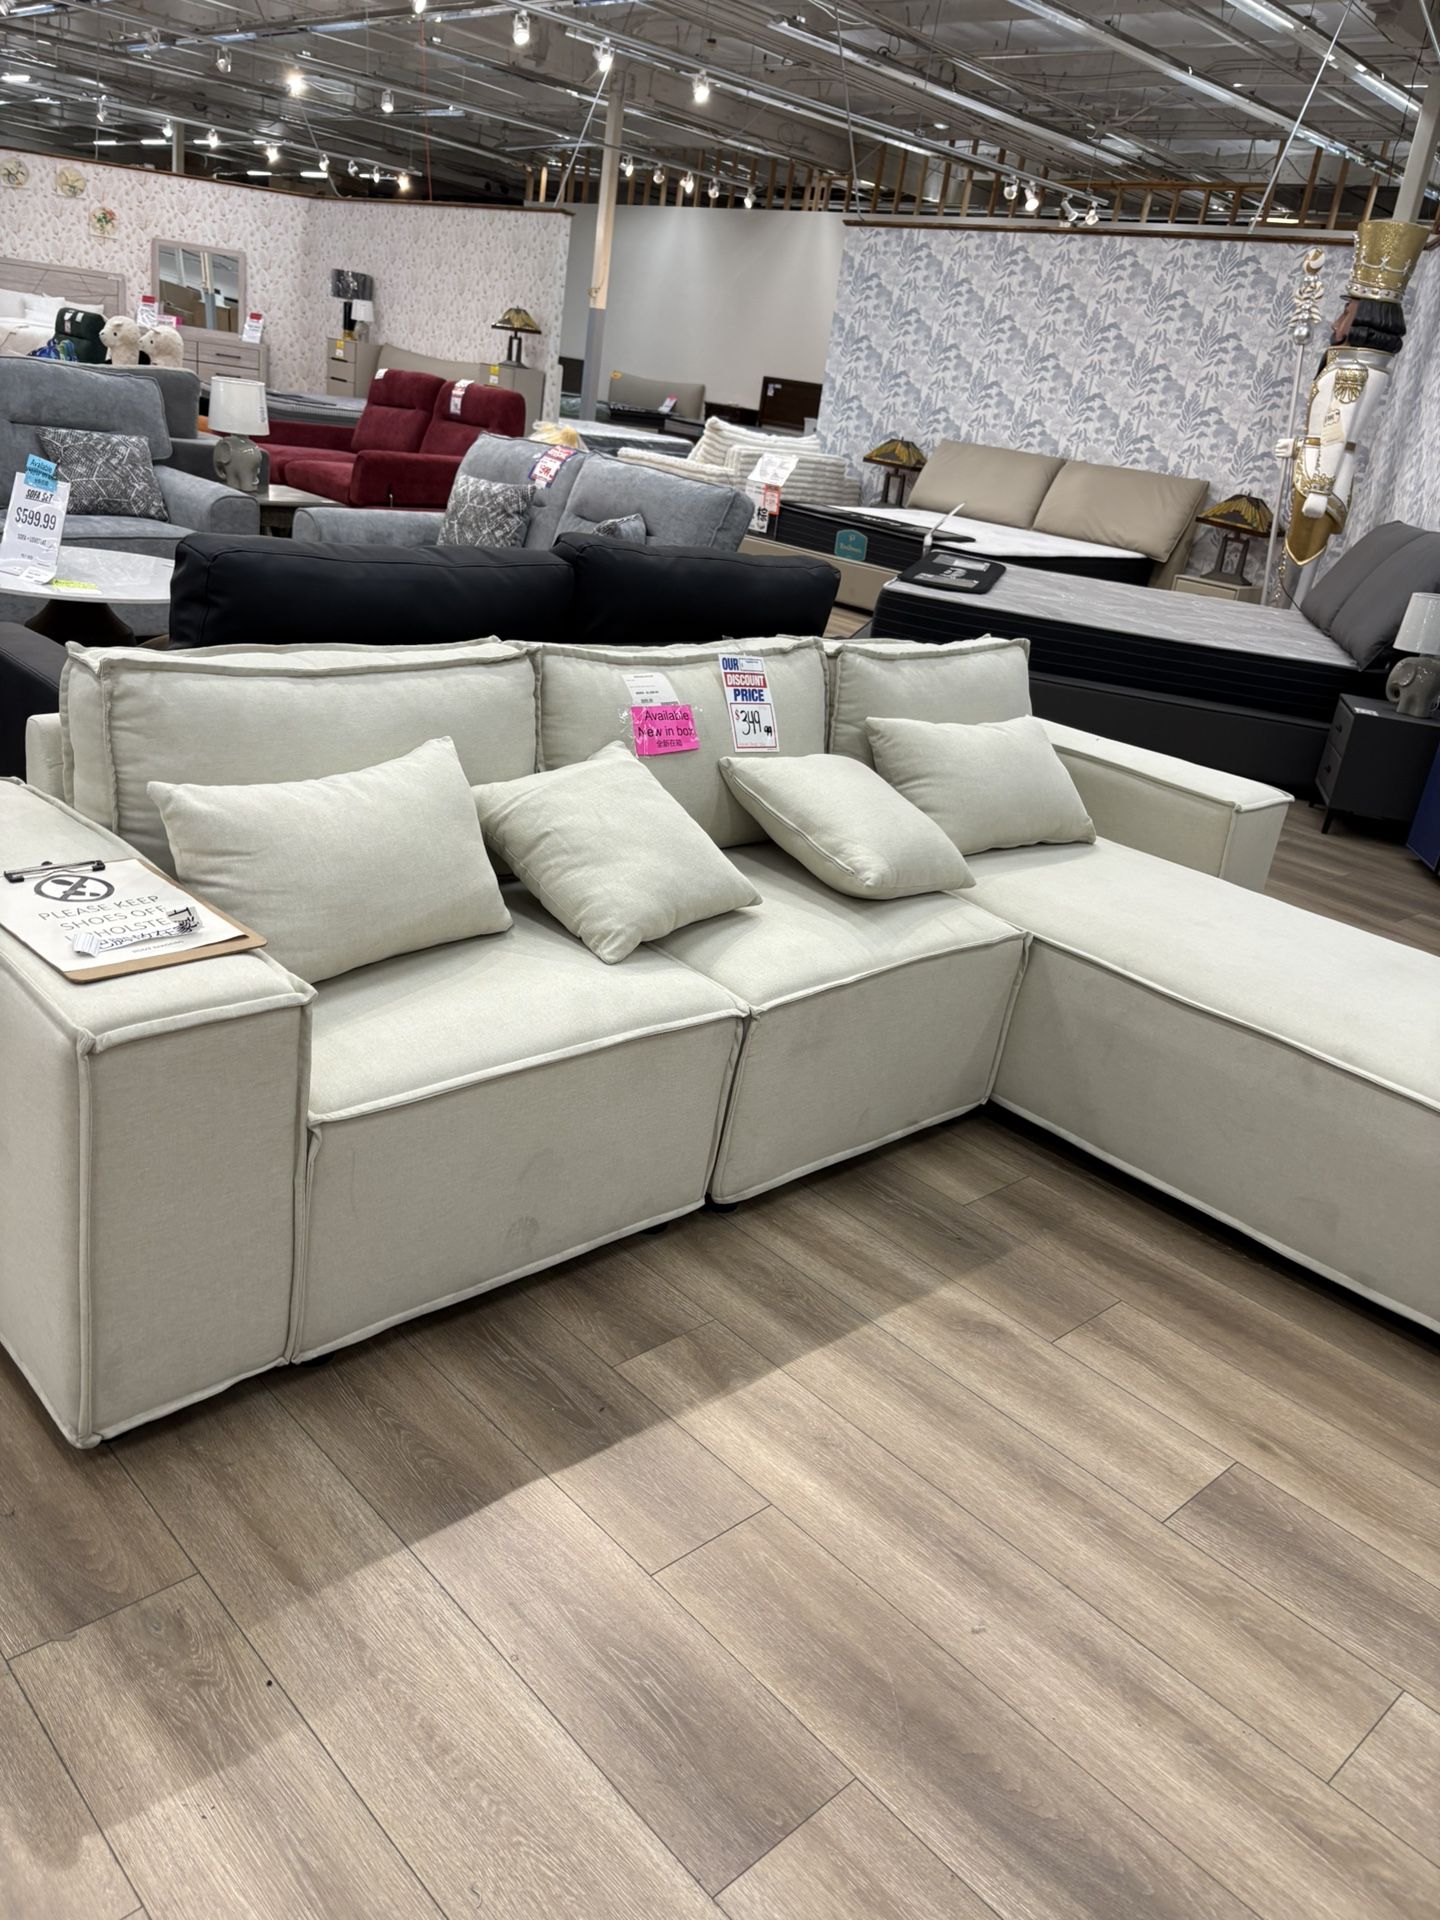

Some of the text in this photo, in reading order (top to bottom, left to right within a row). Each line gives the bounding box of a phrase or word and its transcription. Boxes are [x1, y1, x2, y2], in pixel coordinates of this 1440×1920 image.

[25, 489, 41, 500] SOFA
[15, 506, 57, 531] $599.99
[721, 657, 740, 671] OUR
[726, 673, 765, 687] DISCOUNT
[733, 688, 765, 702] PRICE
[645, 710, 689, 721] Available
[638, 726, 695, 737] New in box
[38, 895, 159, 920] PLEASE KEEP
[60, 905, 167, 931] SHOES OFF
